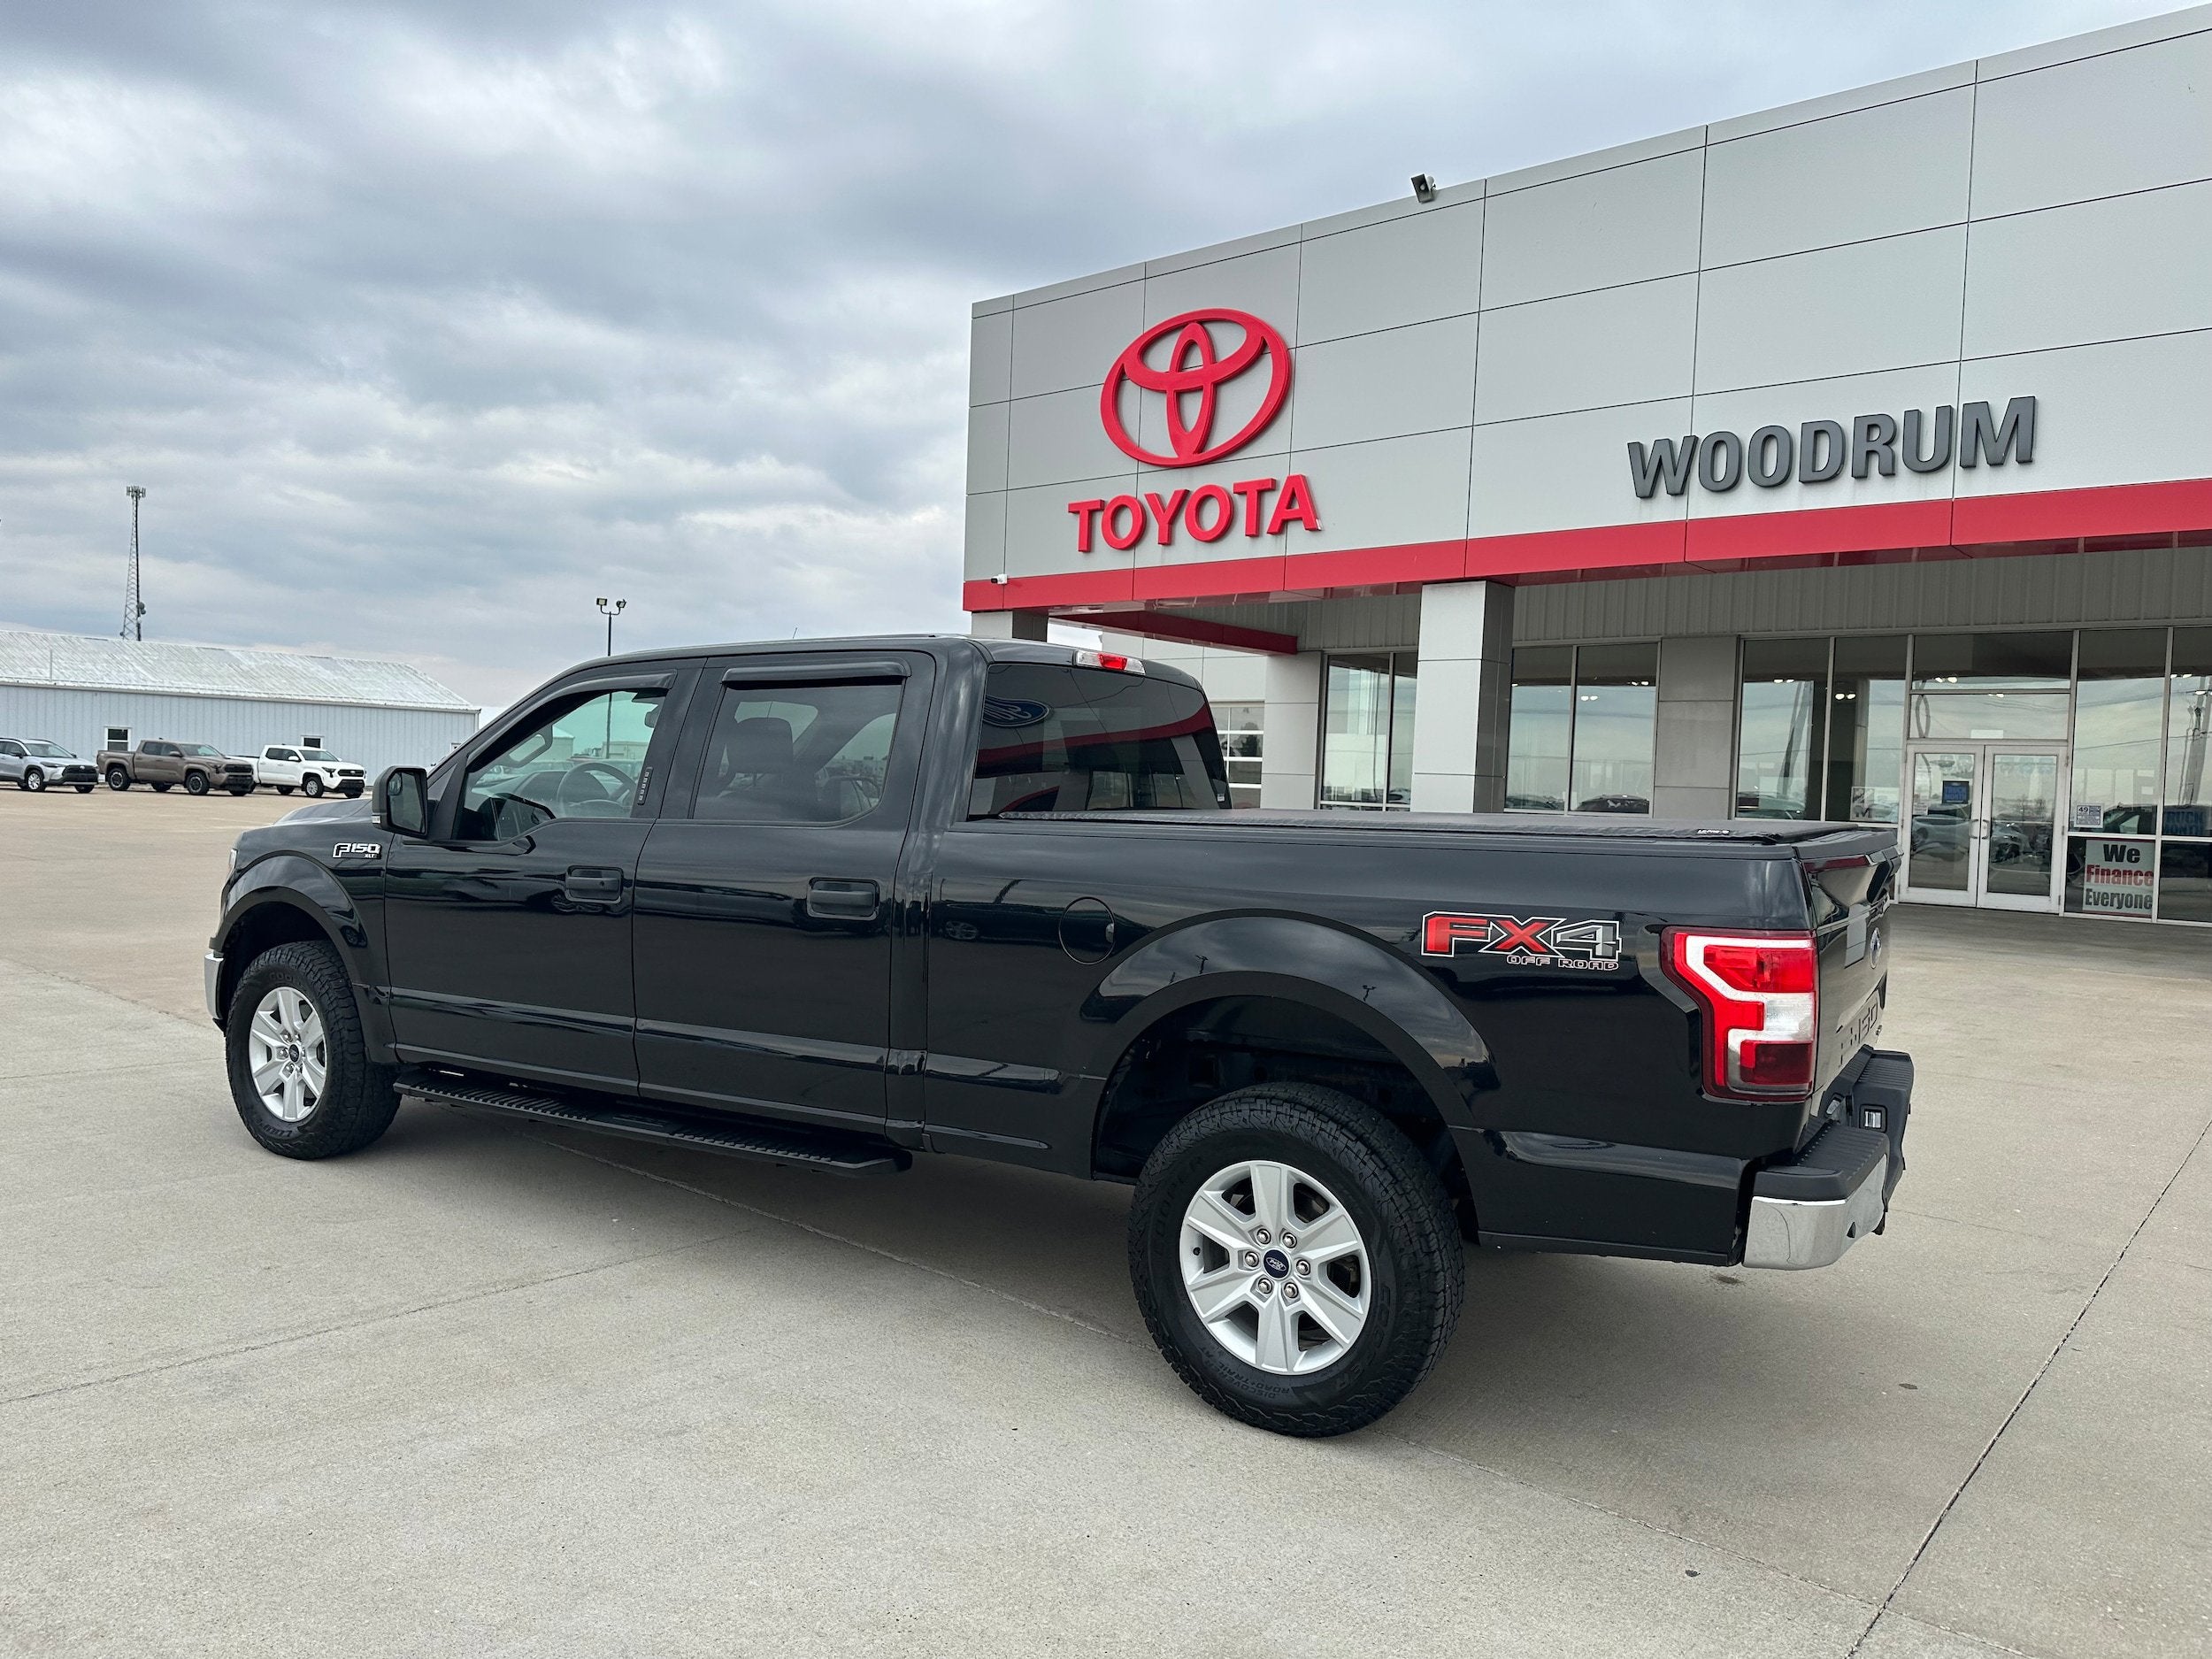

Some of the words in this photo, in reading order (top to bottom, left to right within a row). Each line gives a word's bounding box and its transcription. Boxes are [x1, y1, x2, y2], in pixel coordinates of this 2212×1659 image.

[1627, 396, 2037, 498] WOODRUM
[1068, 473, 1321, 552] TOYOTA
[2103, 844, 2140, 864] We
[2086, 864, 2154, 886] Finance
[2085, 888, 2153, 910] Everyone
[1421, 911, 1622, 962] FX4
[1507, 956, 1550, 965] OFF
[1558, 958, 1619, 971] ROAD
